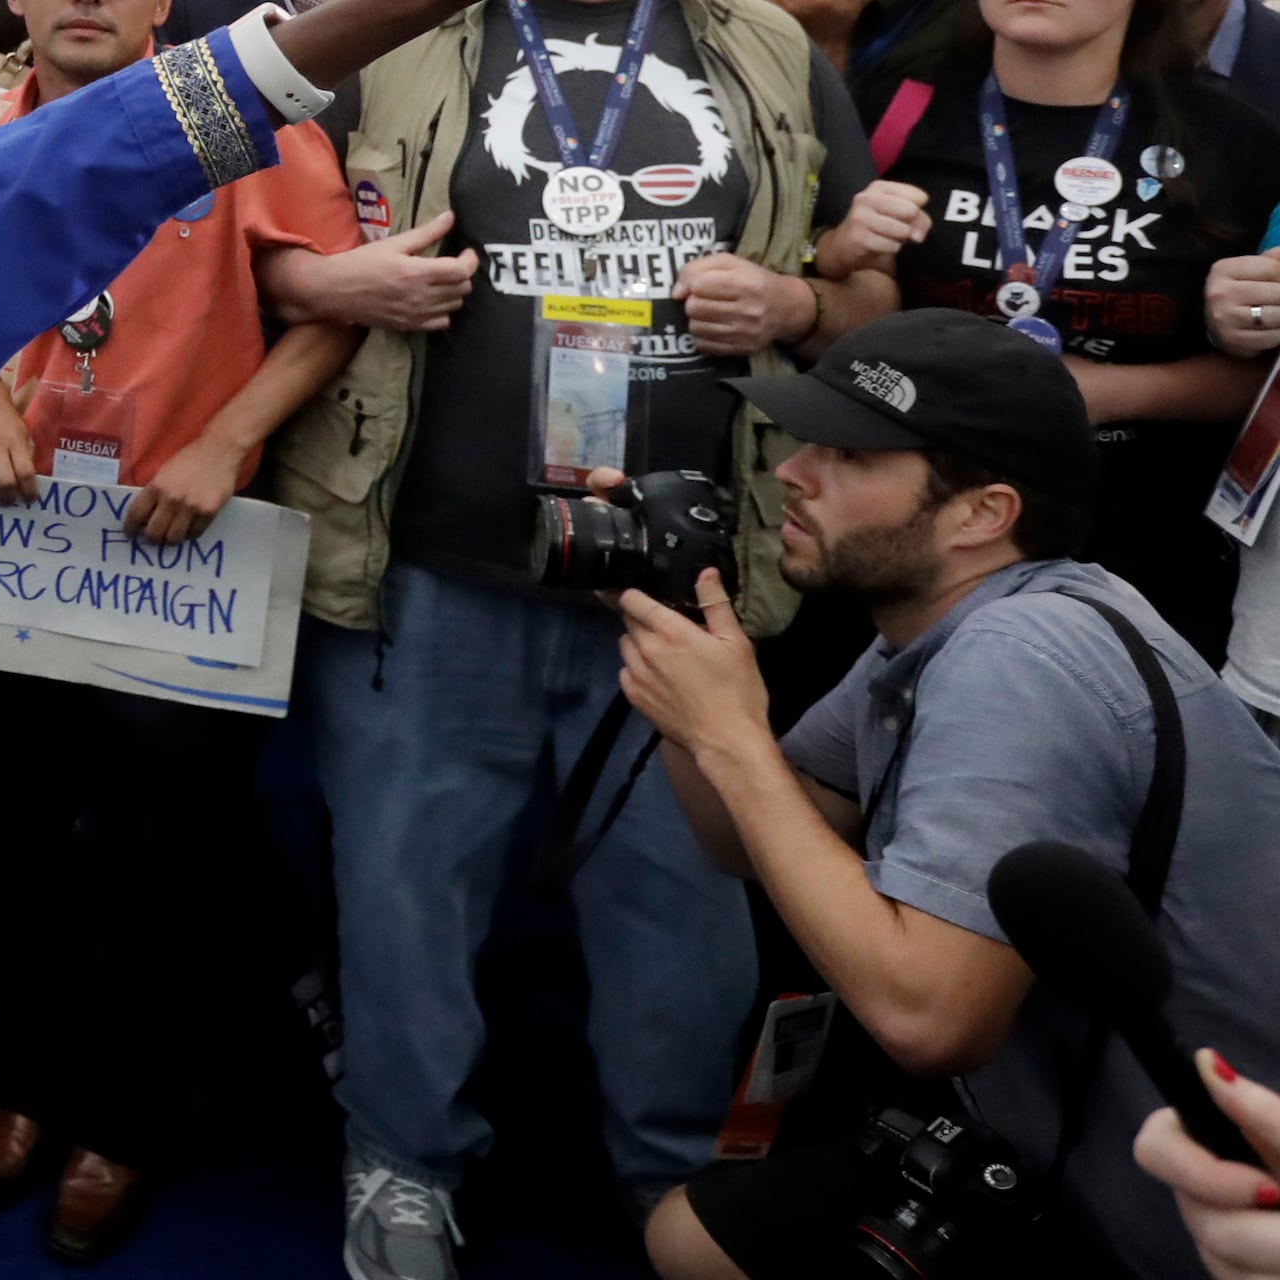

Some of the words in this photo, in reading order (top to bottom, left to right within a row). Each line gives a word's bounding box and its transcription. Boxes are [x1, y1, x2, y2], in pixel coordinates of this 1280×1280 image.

[558, 175, 604, 194] NO
[561, 205, 609, 225] TPP
[532, 222, 656, 244] DERACY
[666, 222, 713, 241] NOW
[960, 229, 1130, 283] LES
[596, 253, 663, 288] THE
[556, 333, 626, 352] TUESDAY
[849, 360, 897, 391] NORTH
[877, 361, 904, 384] THE
[853, 374, 889, 399] FACE
[59, 436, 118, 458] TUESDAY
[101, 528, 224, 578] FROM
[55, 565, 237, 634] CAMPAIGN
